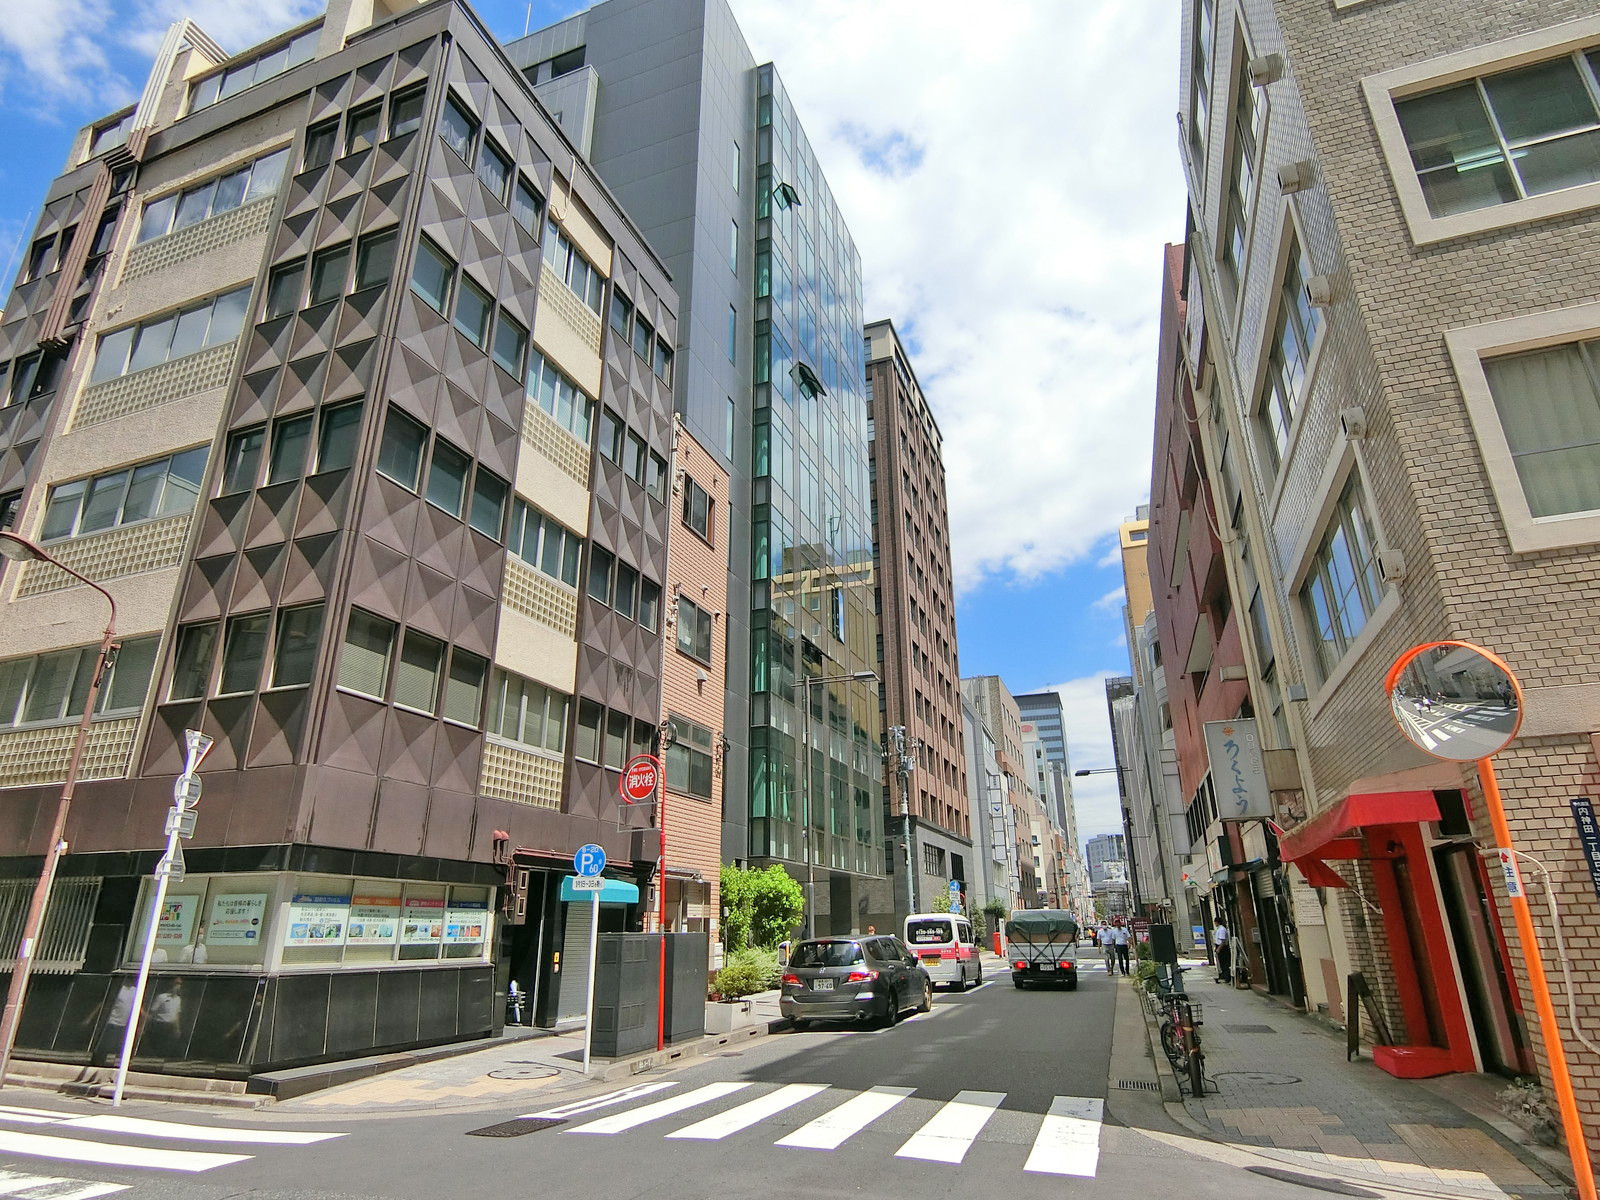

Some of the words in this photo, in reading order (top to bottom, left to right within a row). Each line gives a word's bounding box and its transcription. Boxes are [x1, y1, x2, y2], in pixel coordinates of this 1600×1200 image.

[629, 772, 654, 788] 消火栓
[1223, 739, 1248, 815] ろくよう
[581, 853, 594, 874] P
[1505, 866, 1518, 893] 注意
